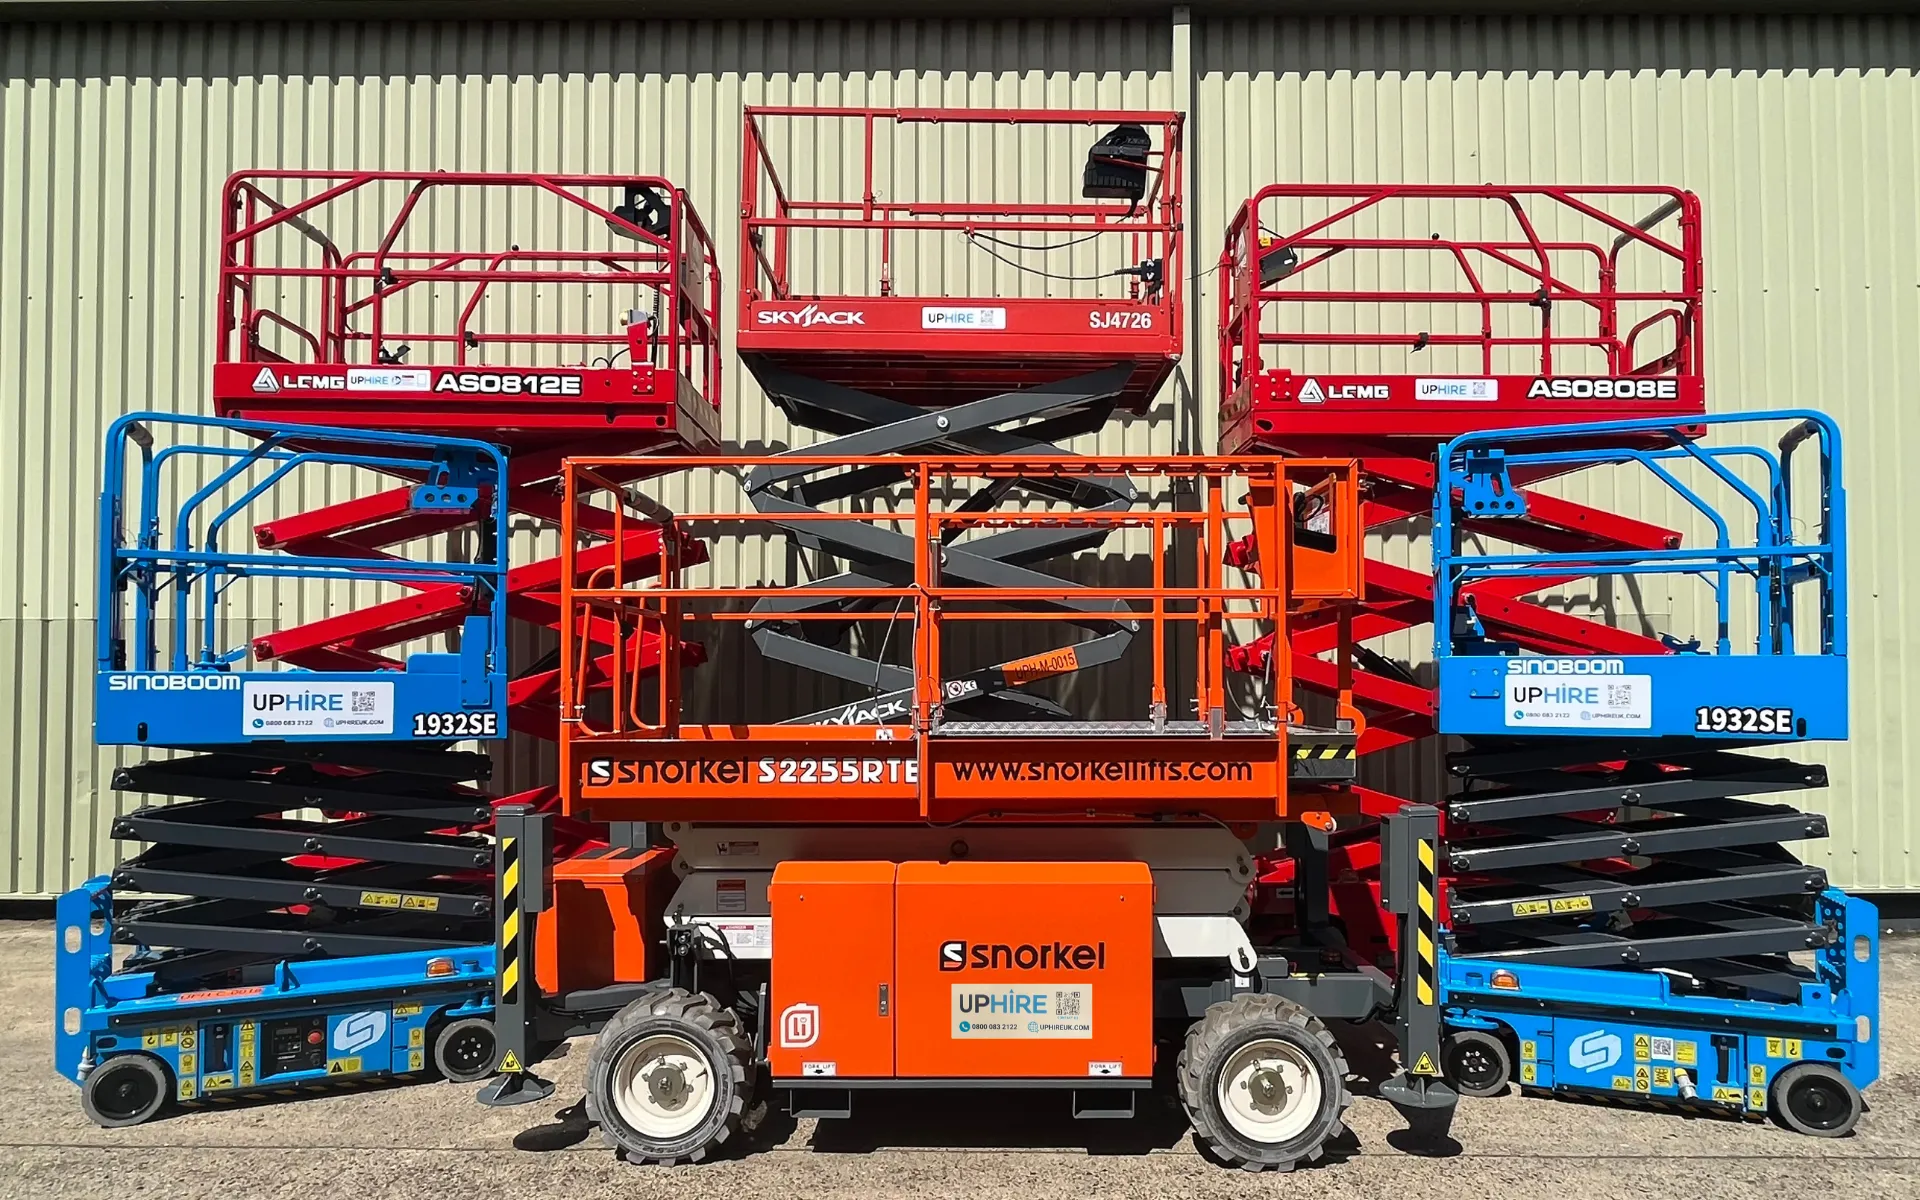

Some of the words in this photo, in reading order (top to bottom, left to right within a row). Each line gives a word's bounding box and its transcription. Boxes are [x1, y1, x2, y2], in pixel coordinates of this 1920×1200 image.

[757, 303, 865, 328] SKYJACK
[928, 311, 974, 324] UPHIRE
[1089, 311, 1152, 329] SJ4726
[350, 375, 389, 385] UPHIRE
[1421, 383, 1467, 395] UPHIRE
[1014, 652, 1076, 680] UPH-M-0015
[1507, 659, 1624, 675] SINOBOOM
[109, 675, 240, 691] SINOBOOM
[1513, 683, 1599, 704] UPHIRE
[253, 689, 343, 711] UPHIRE
[414, 714, 497, 736] 1932SE
[1696, 708, 1791, 733] 1932SE
[618, 758, 749, 785] snorkel
[757, 757, 918, 784] S2255RTE
[952, 760, 1253, 781] www.snorkellifts.com
[971, 942, 1105, 970] snorkel
[959, 988, 1048, 1014] UPHIRE
